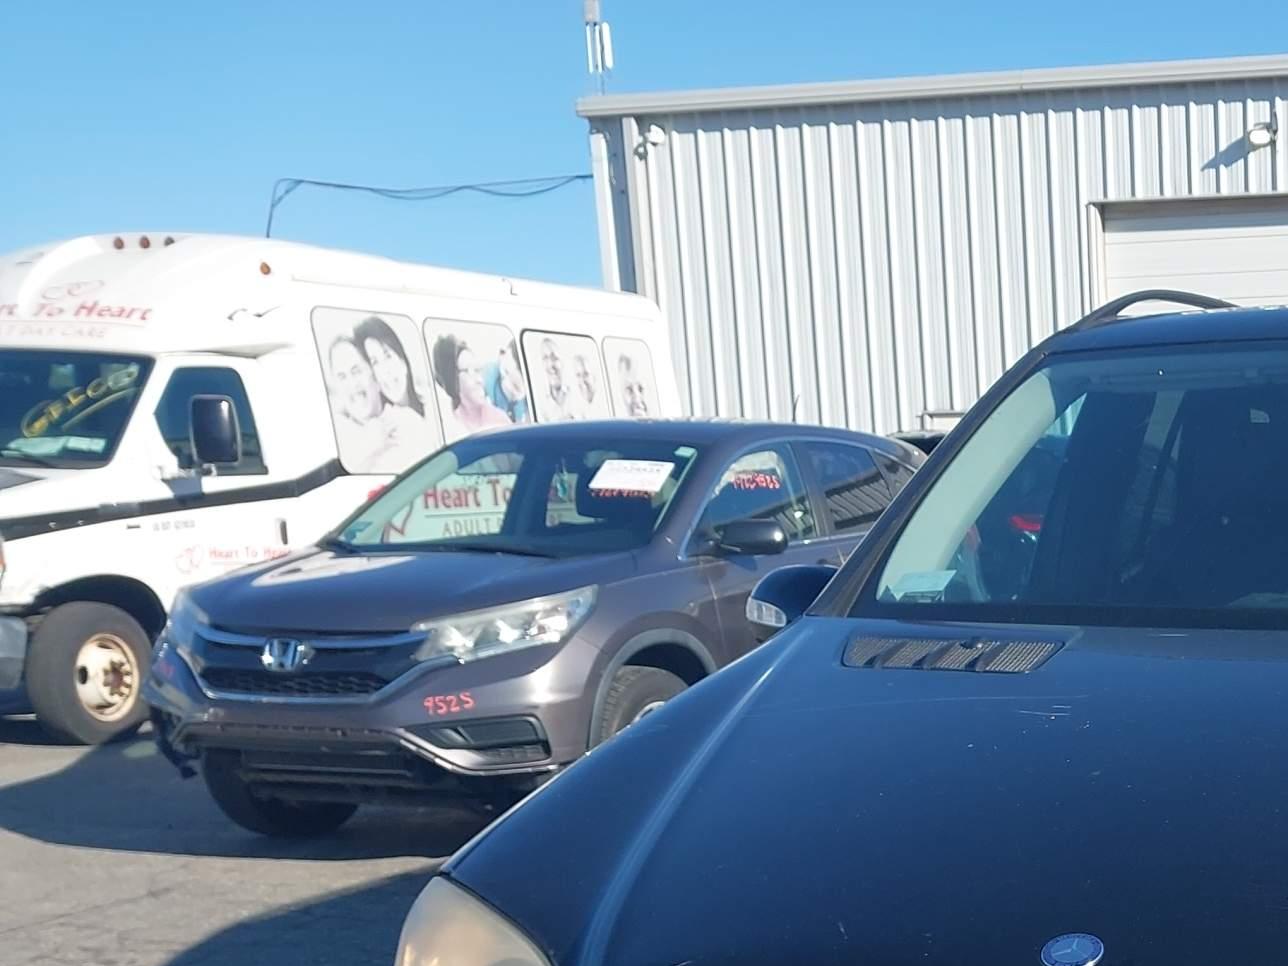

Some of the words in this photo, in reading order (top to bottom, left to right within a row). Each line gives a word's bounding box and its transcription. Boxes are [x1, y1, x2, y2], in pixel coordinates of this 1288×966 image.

[33, 302, 64, 318] To
[73, 300, 153, 321] Heart
[423, 484, 481, 510] Heart
[441, 517, 491, 537] ADULT
